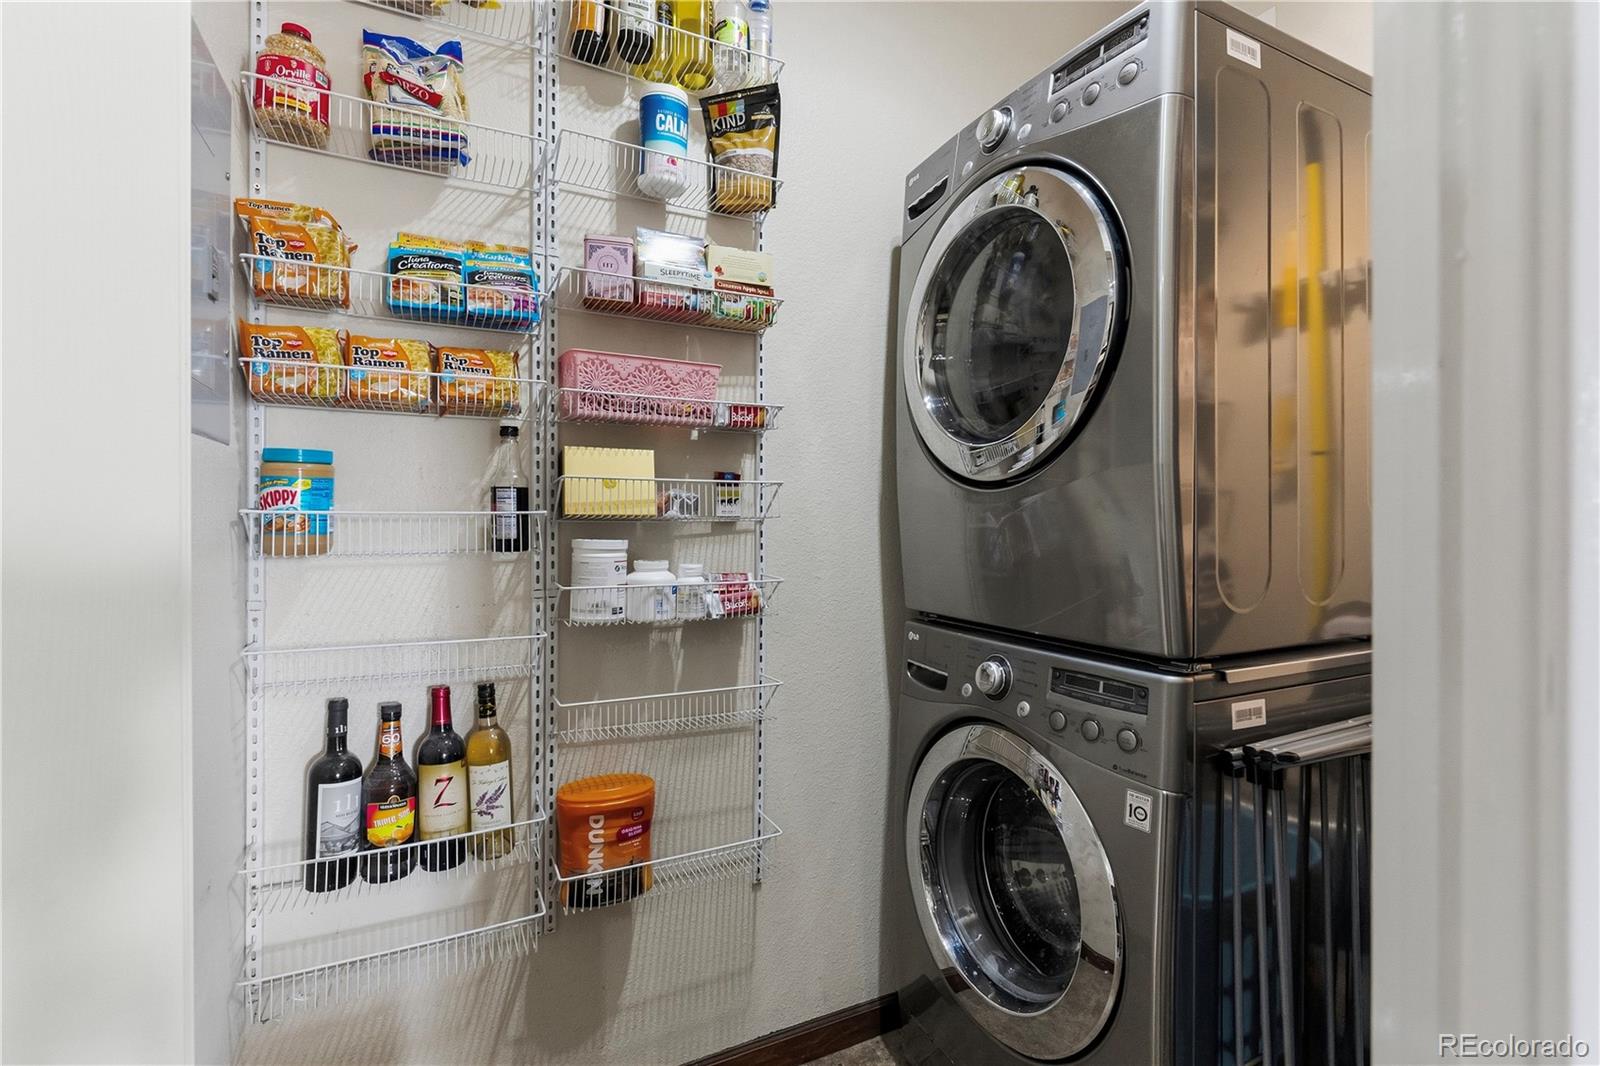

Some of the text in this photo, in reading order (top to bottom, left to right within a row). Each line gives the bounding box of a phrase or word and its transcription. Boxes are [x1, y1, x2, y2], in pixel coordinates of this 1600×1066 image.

[276, 64, 311, 80] Orville
[711, 112, 746, 133] KIND
[255, 231, 287, 250] Top
[257, 244, 315, 262] Ramen
[402, 254, 431, 263] Tuna
[397, 259, 455, 271] Creations
[474, 272, 529, 282] Creations
[660, 267, 702, 282] SLEEPYTIME
[251, 335, 283, 350] Top
[253, 347, 312, 360] Ramen
[352, 346, 380, 360] Top
[442, 352, 468, 366] Top
[352, 356, 405, 369] Ramen
[442, 361, 492, 376] Ramen
[382, 732, 401, 744] 60
[433, 775, 458, 809] Z
[1128, 803, 1149, 822] 10
